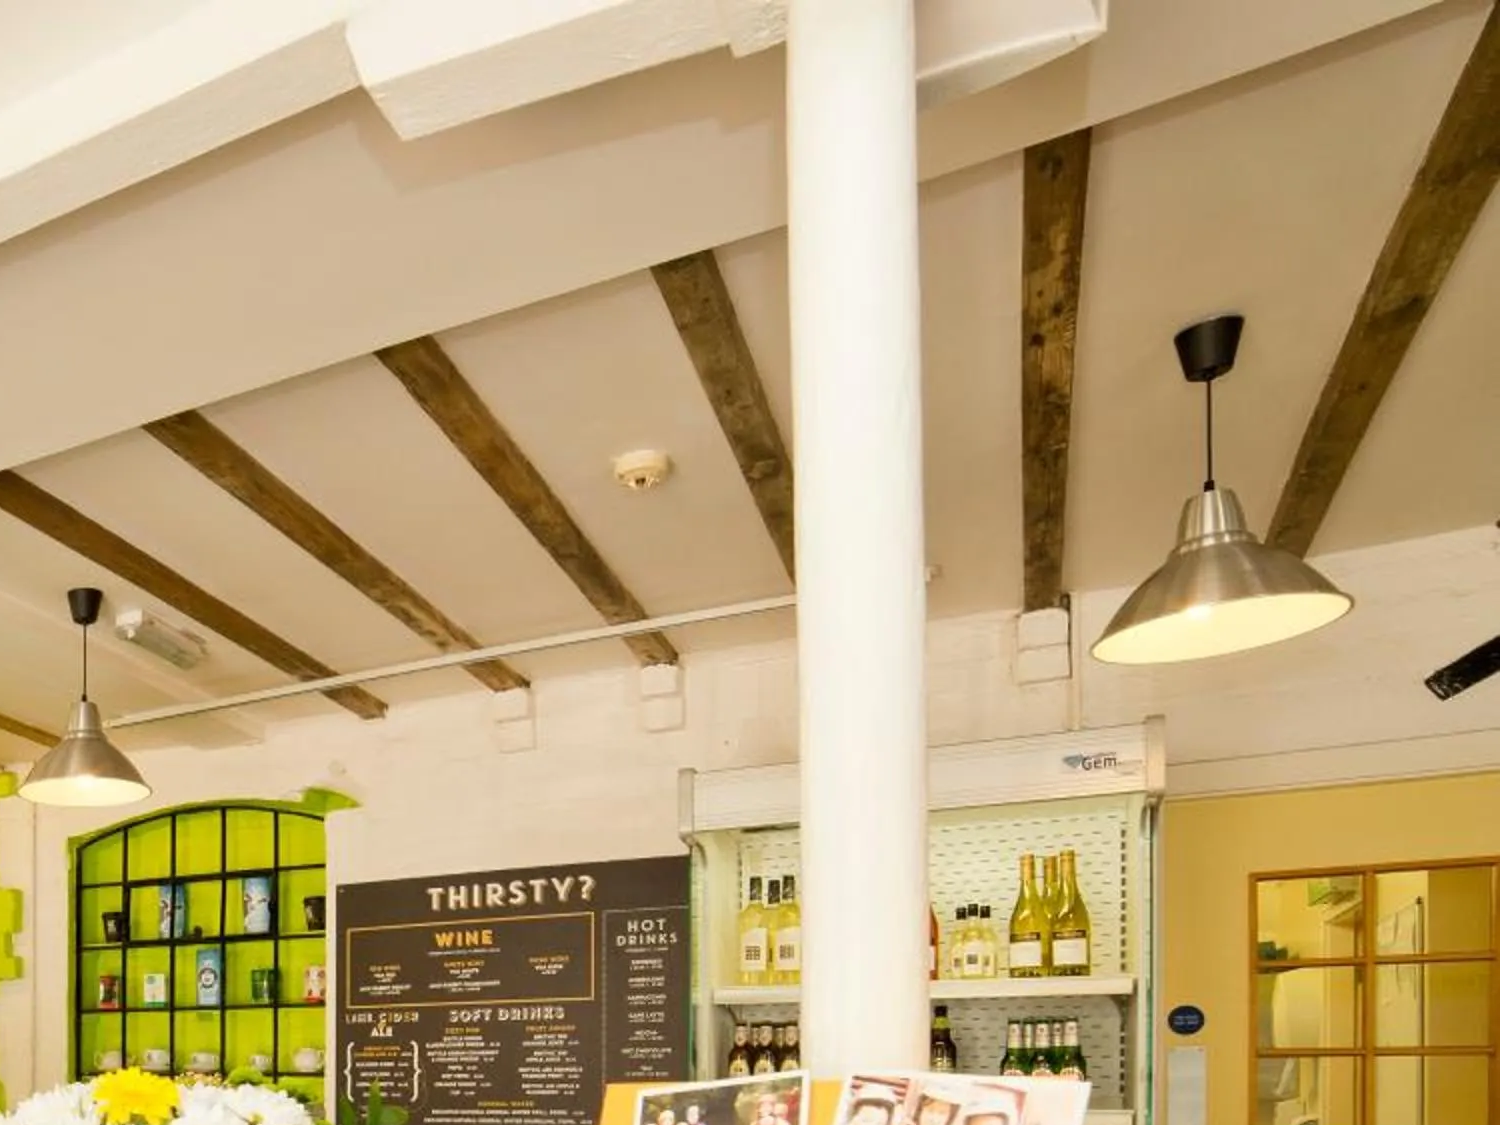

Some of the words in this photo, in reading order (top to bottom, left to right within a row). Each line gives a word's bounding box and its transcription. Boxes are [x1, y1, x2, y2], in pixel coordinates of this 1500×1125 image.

[1081, 756, 1118, 771] Gem
[425, 875, 596, 912] THIRSTY?
[626, 917, 667, 933] HOT
[434, 929, 494, 948] WINE
[615, 931, 679, 948] DRINKS
[448, 1008, 493, 1024] SOFT
[497, 1006, 566, 1022] DRINKS
